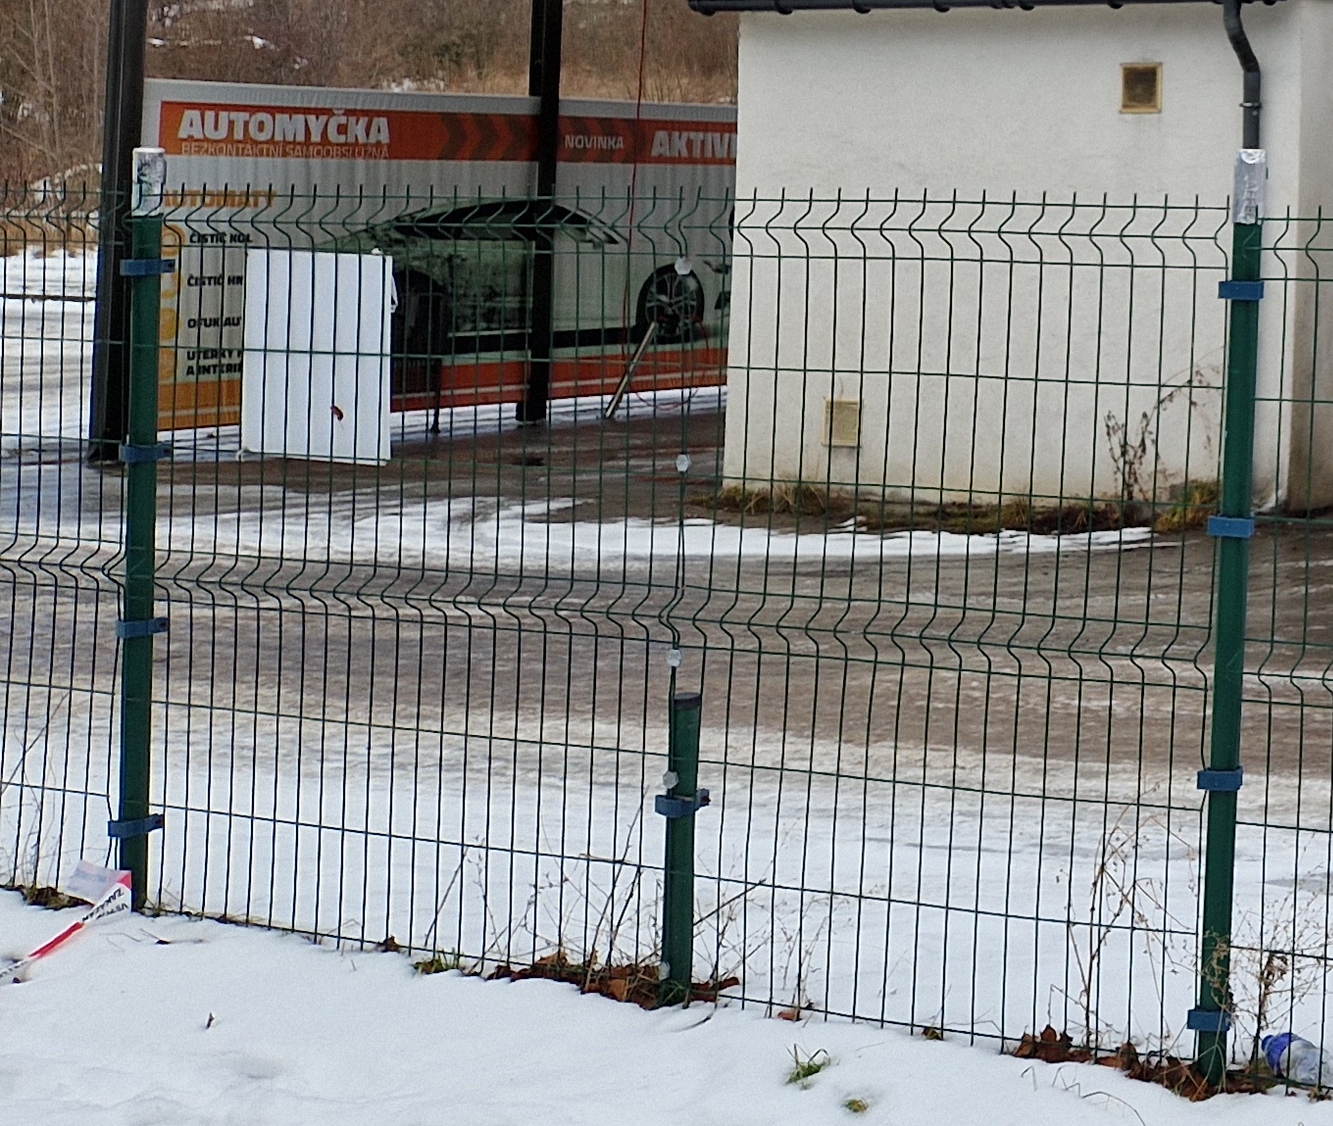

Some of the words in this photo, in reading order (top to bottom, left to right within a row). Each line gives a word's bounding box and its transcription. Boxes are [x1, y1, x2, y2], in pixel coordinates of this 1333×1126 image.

[178, 108, 390, 144] AUTOMYČKA
[182, 141, 282, 158] BEZKONTAKTNÍ
[564, 134, 625, 150] NOVINKA
